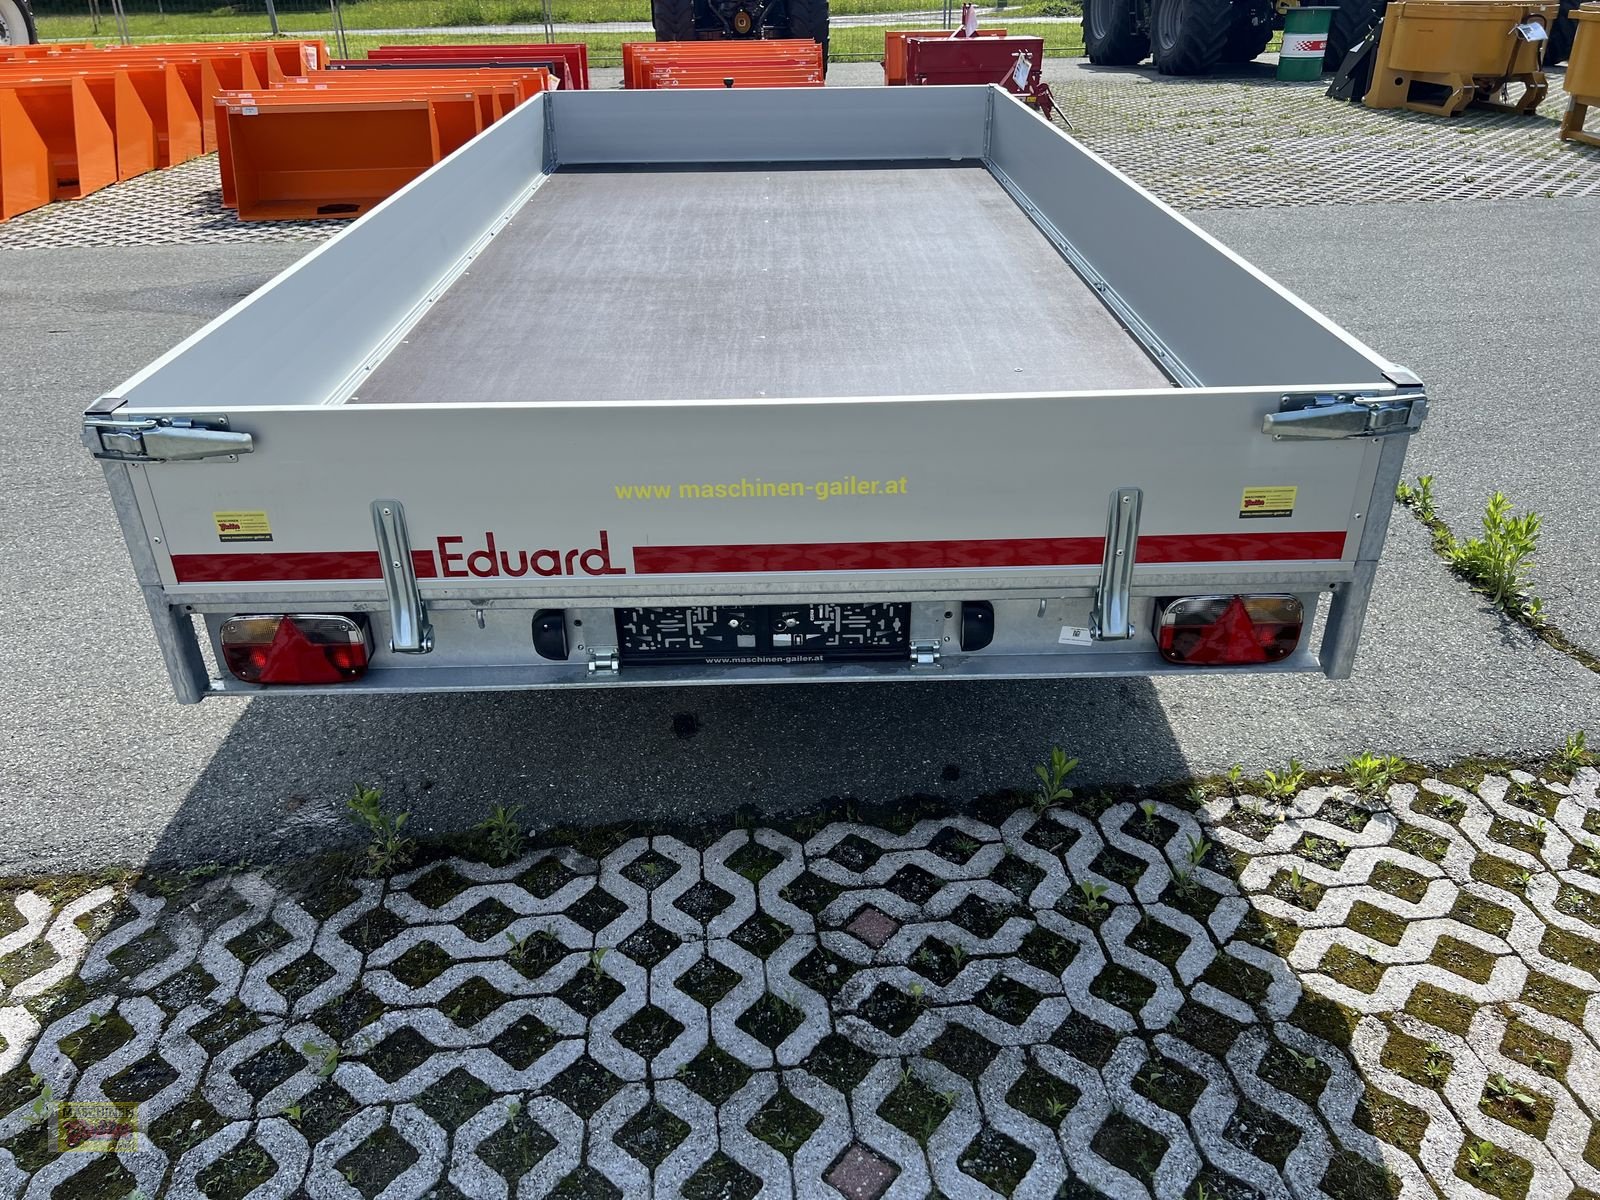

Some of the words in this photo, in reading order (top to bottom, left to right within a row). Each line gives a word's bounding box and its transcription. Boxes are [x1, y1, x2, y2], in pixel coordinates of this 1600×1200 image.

[614, 484, 672, 499] www
[679, 476, 908, 502] maschinen-gailer.at
[436, 530, 627, 578] Eduard
[705, 655, 824, 664] www.maschinen-gailer.at
